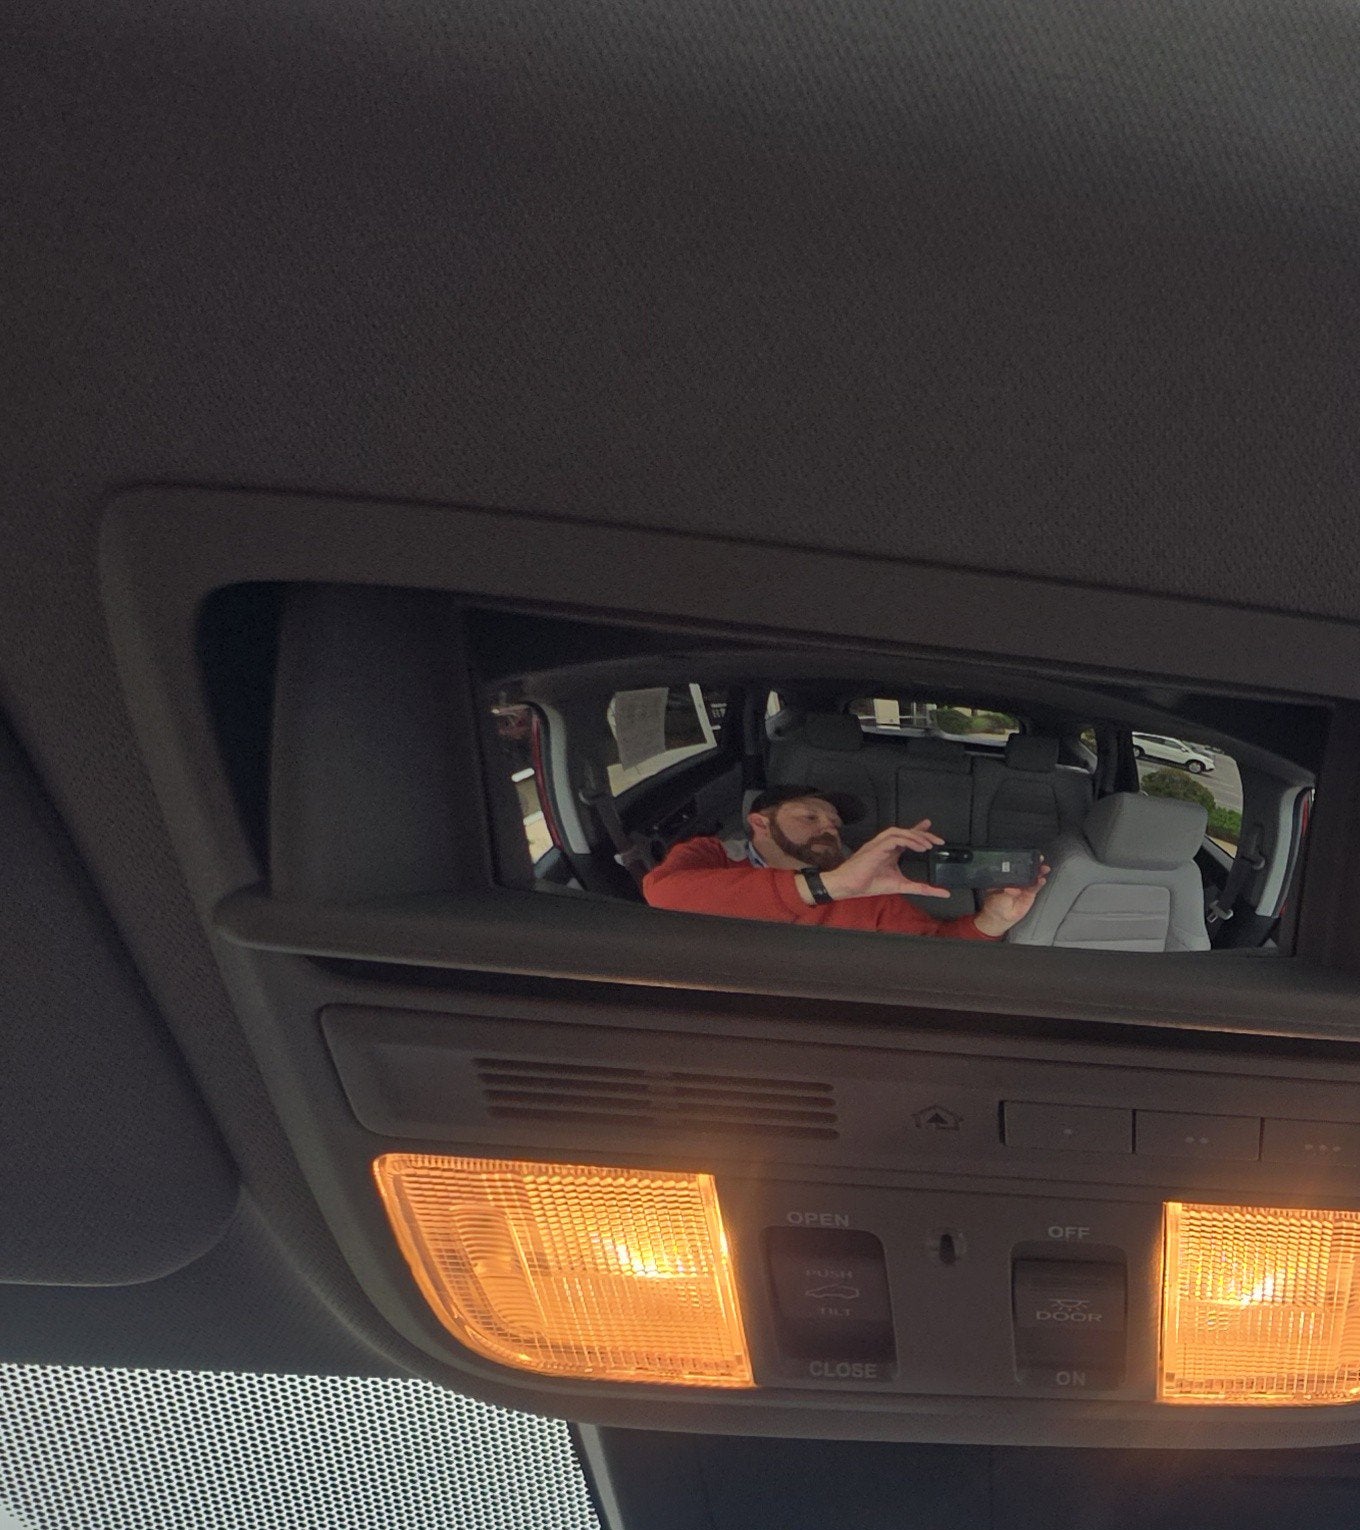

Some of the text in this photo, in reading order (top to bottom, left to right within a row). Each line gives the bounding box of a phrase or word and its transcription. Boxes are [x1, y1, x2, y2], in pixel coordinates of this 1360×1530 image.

[786, 1211, 850, 1227] OPEN
[1047, 1226, 1091, 1240] OFF
[805, 1269, 853, 1279] PUSH
[818, 1307, 852, 1318] TILT
[1035, 1310, 1103, 1323] DOOR
[809, 1361, 878, 1379] CLOSE
[1056, 1370, 1086, 1387] ON
